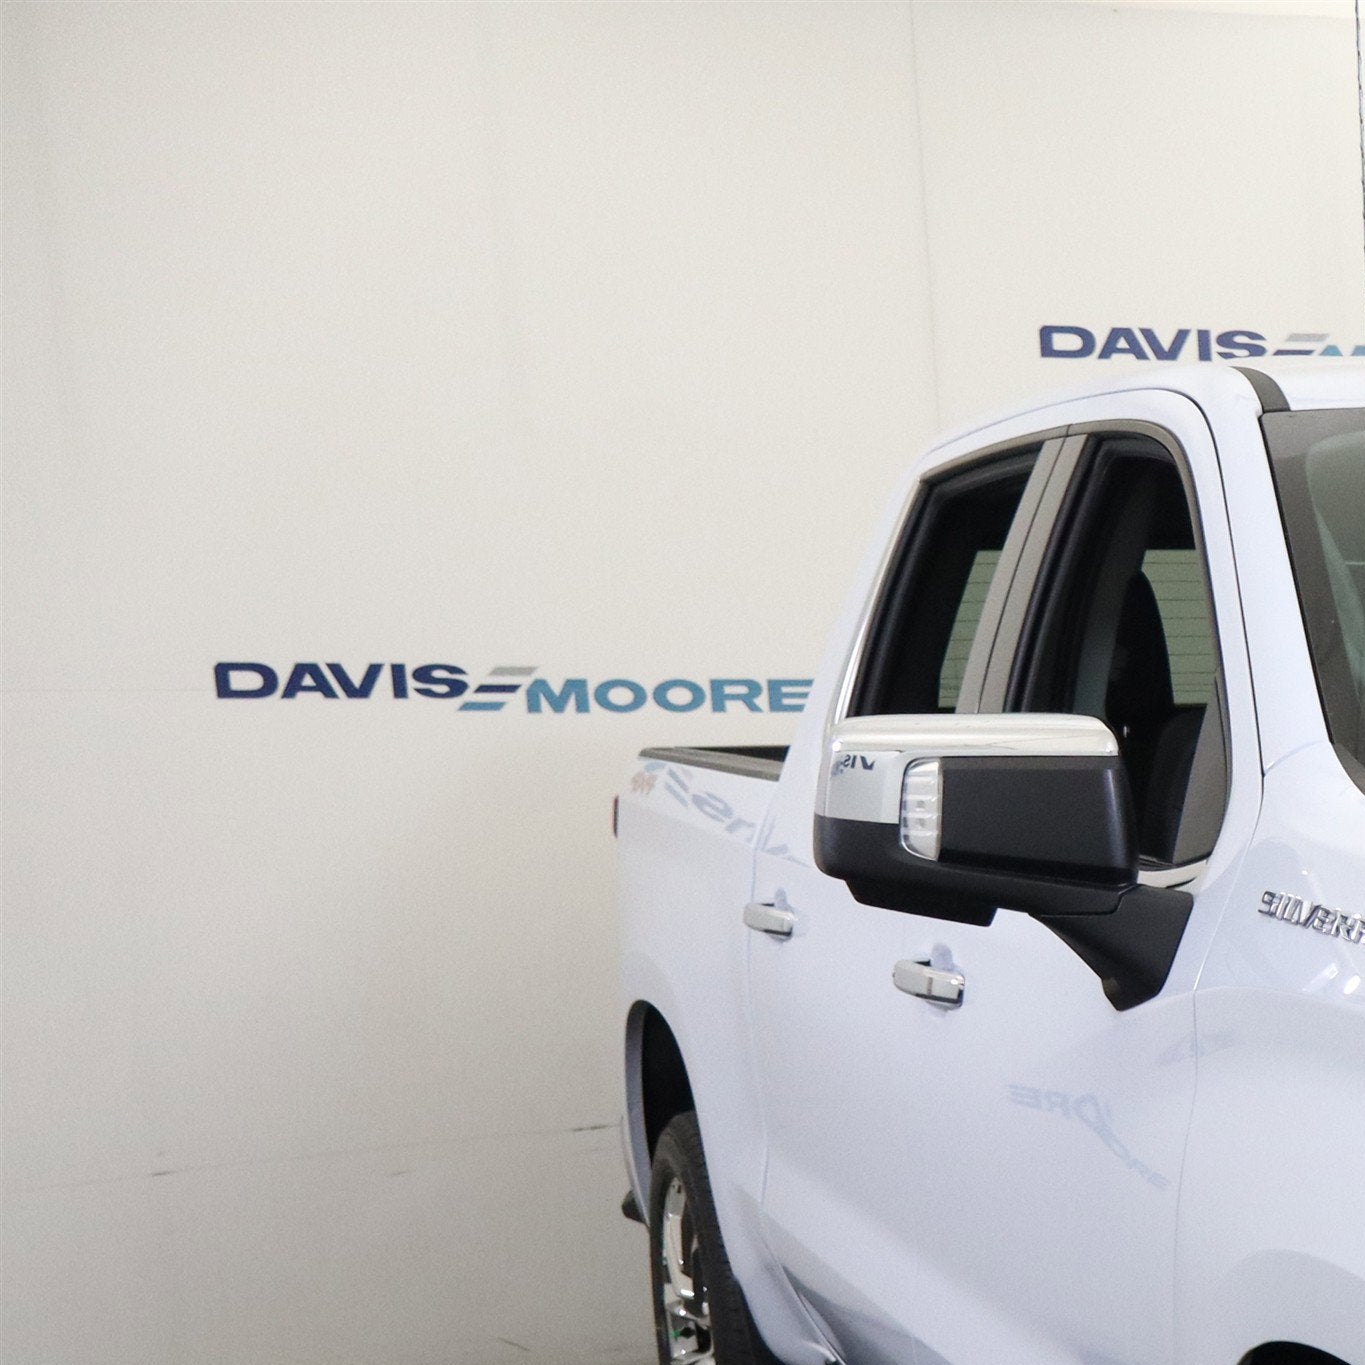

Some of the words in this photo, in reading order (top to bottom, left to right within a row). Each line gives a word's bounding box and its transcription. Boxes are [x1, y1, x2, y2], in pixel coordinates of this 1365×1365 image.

[1039, 325, 1267, 362] DAVIS
[213, 661, 470, 700] DAVIS
[525, 678, 814, 714] MOORE
